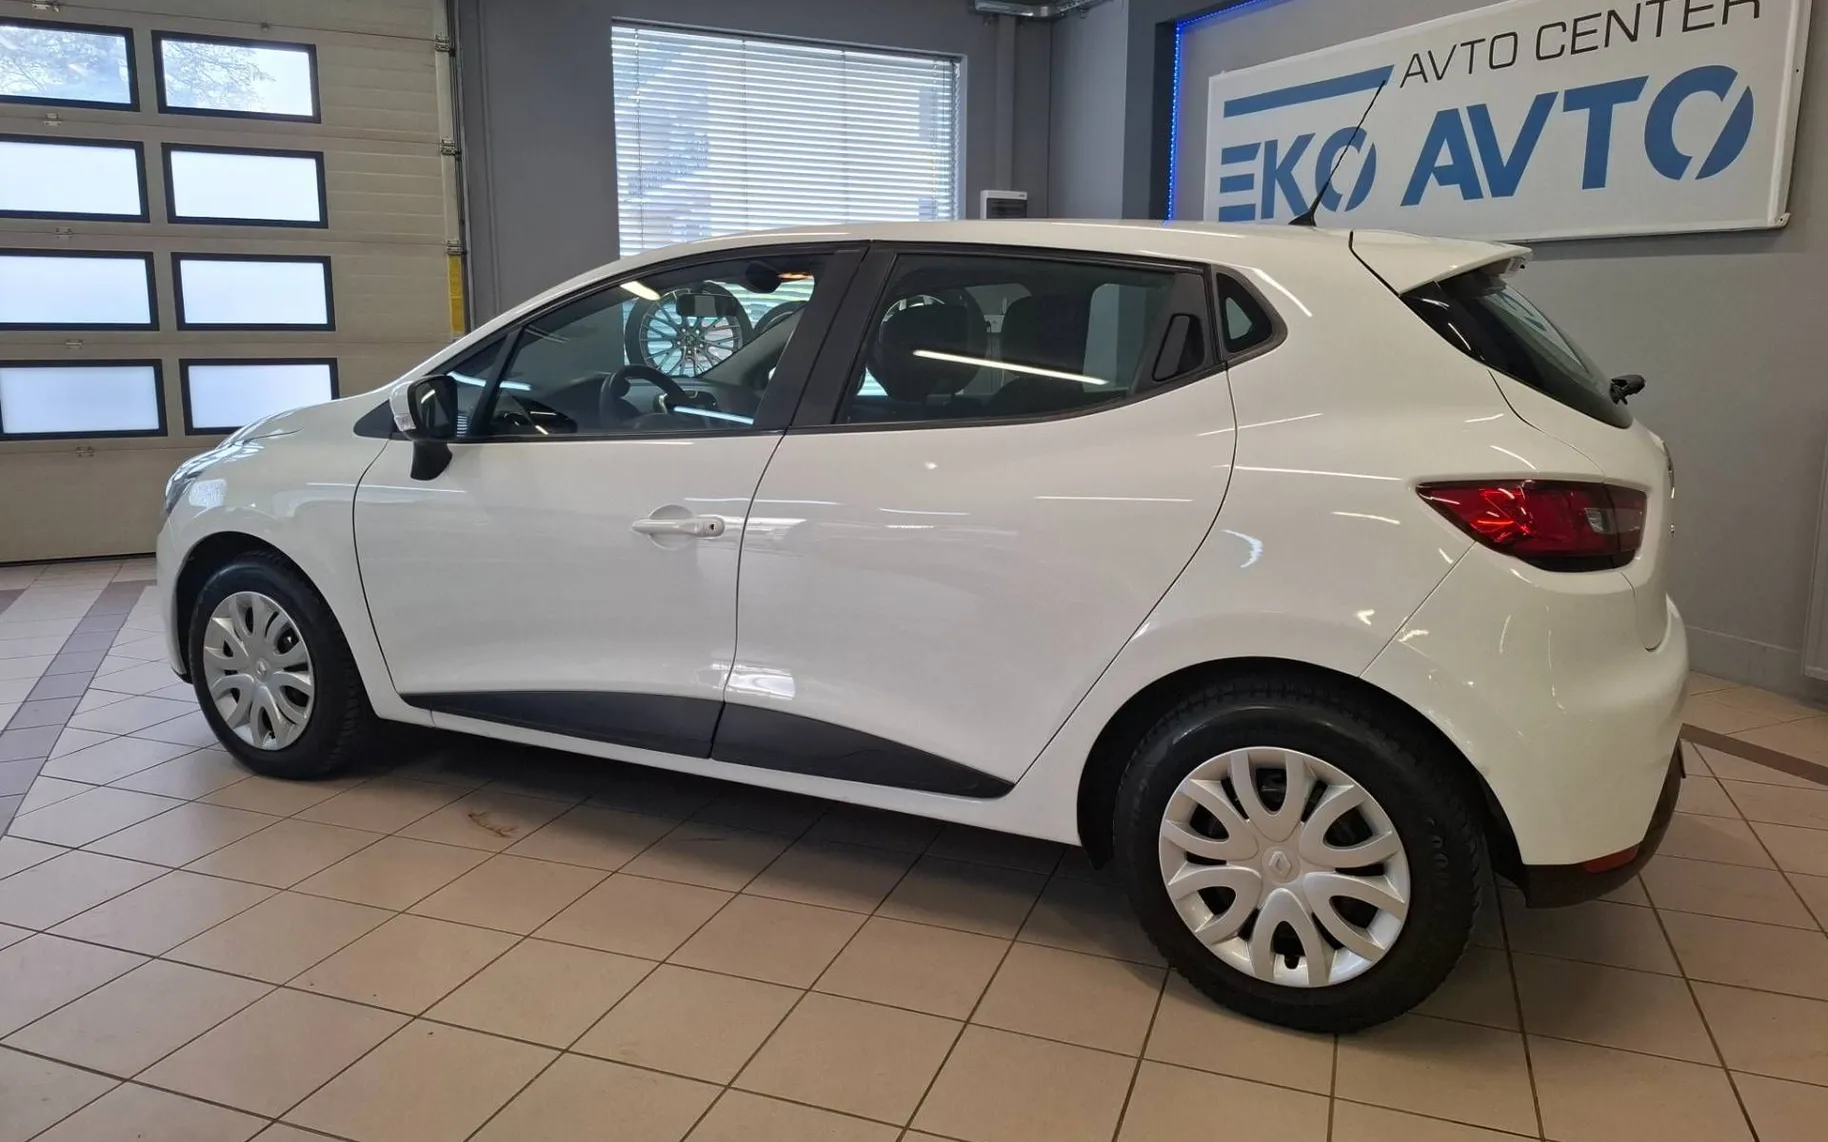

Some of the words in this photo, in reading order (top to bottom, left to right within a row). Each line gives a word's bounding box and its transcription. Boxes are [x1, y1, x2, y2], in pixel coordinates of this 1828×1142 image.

[1400, 31, 1518, 88] AVTO
[1218, 126, 1377, 222] EKO
[1401, 65, 1754, 207] AVTO
